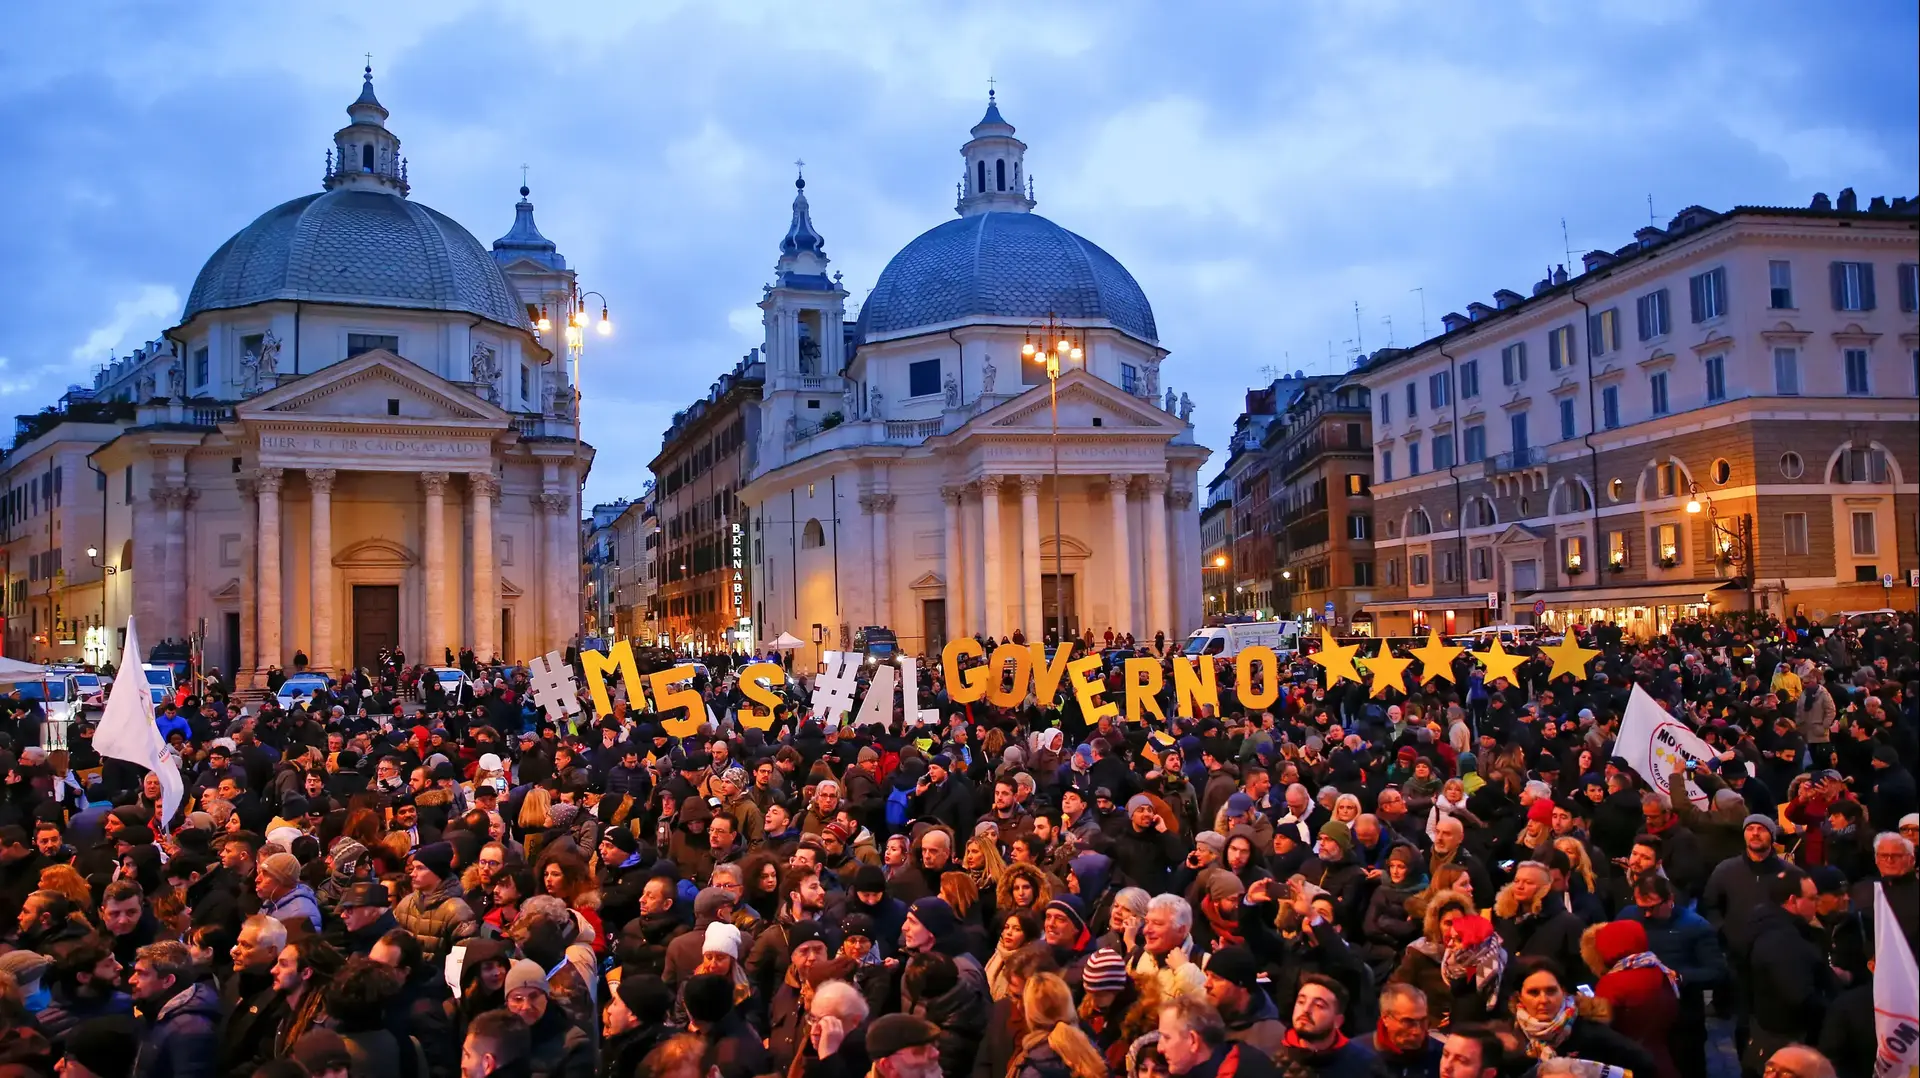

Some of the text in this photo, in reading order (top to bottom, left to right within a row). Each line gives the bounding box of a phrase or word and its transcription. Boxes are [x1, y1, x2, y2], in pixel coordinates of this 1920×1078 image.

[732, 523, 743, 617] BERNABEI
[811, 651, 940, 726] #AL
[942, 637, 1280, 726] GOVERNO
